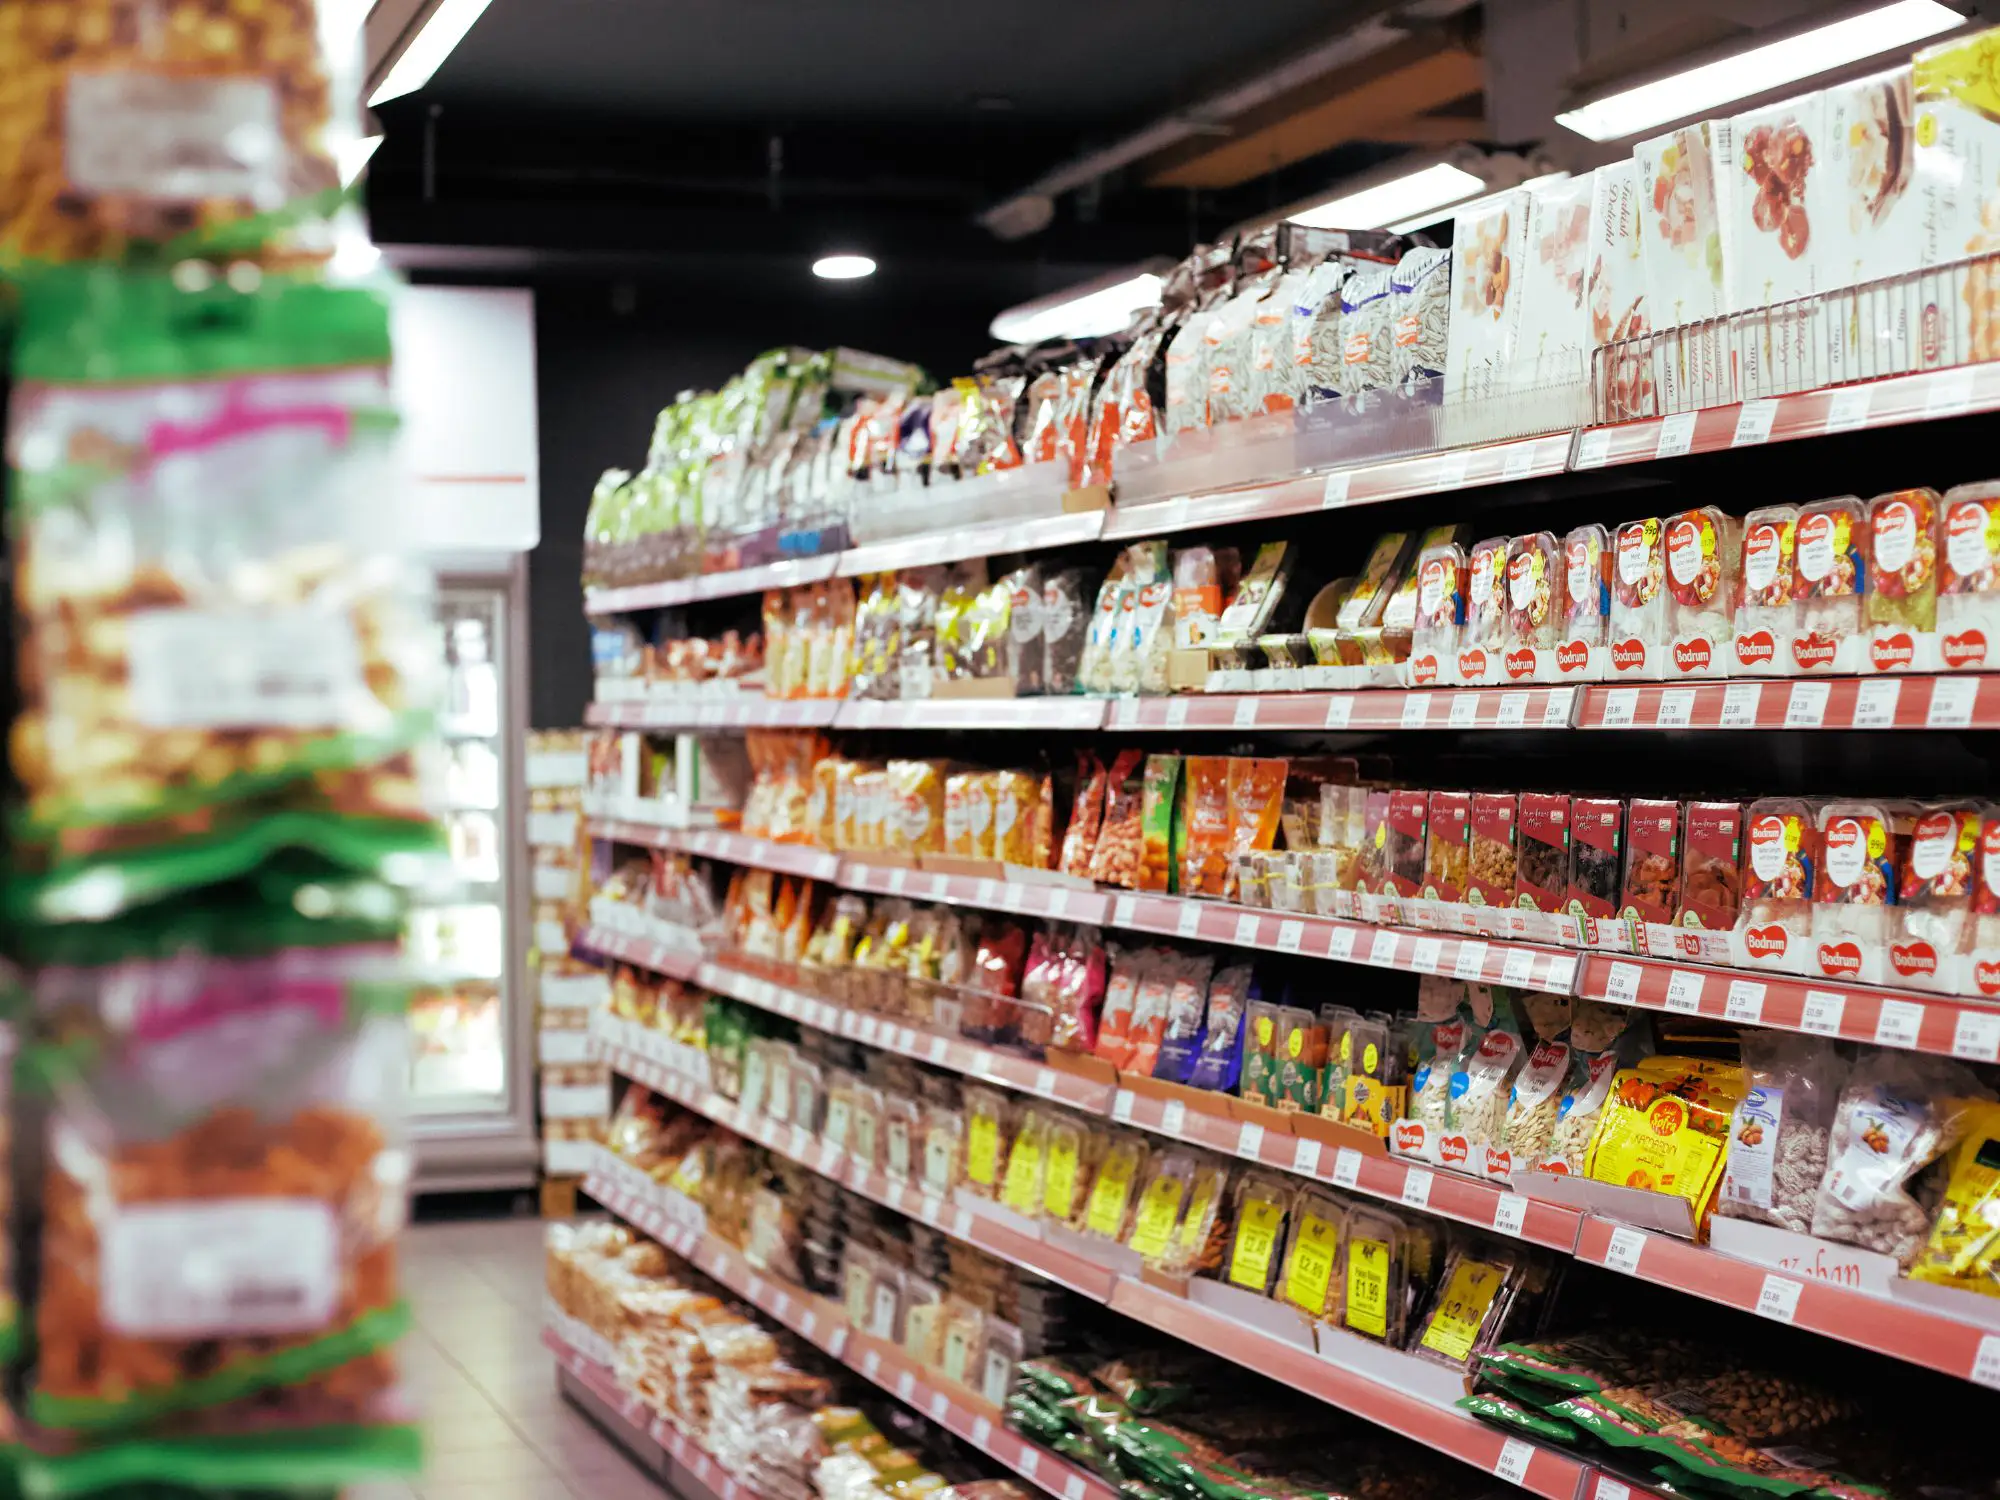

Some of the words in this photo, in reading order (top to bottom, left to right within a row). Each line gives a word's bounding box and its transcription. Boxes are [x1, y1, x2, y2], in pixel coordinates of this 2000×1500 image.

[1604, 183, 1619, 247] Delight
[1619, 178, 1633, 239] Turkish
[1644, 525, 1657, 535] 99p
[1620, 535, 1642, 547] Bodrum
[1668, 533, 1692, 546] Bodrum
[1738, 643, 1772, 656] Bodrum
[1874, 646, 1911, 660] Bodrum
[1946, 643, 1985, 657] Bodrum
[1558, 652, 1586, 664] Bodrum
[1614, 650, 1643, 663] Bodrum
[1676, 650, 1709, 663] Bodrum
[1461, 659, 1485, 671] Bodrum
[1507, 658, 1534, 670] Bodrum
[1752, 828, 1779, 838] Bodrum
[1748, 935, 1785, 950] Bodrum
[1821, 951, 1860, 967] Bodrum
[1895, 951, 1934, 967] Bodrum
[1399, 1130, 1423, 1143] Bodrum
[1441, 1142, 1466, 1157] Bodrum
[1355, 1279, 1379, 1303] £1.99
